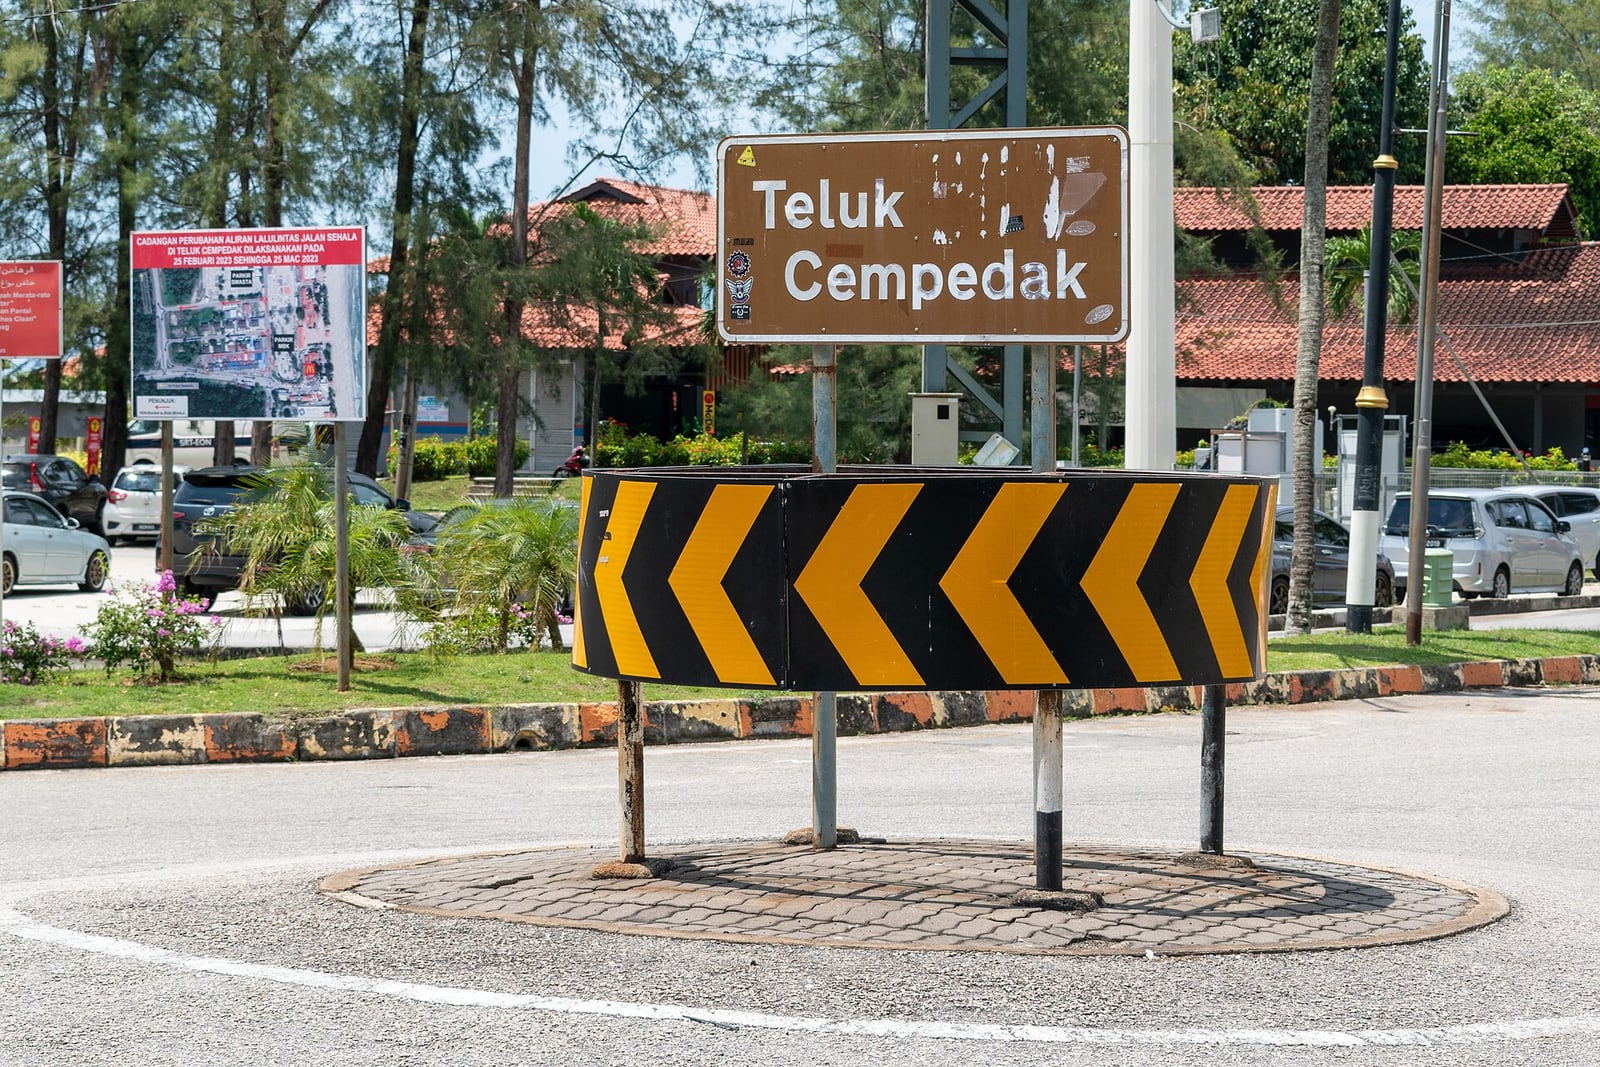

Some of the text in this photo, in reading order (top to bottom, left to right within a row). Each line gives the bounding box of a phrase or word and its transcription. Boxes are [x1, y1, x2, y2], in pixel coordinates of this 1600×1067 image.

[752, 177, 905, 230] Teluk
[136, 232, 358, 246] CADANGAN PERUBAHAN ALIRAN LALULINTAS JALAN SEHALA
[167, 243, 325, 256] DI TELUK CEMPEDAK DILAKSANAKAN PADA
[173, 254, 319, 266] 25 FEBUARI 2023 SEHINGGA 25 MAC 2023
[784, 248, 1088, 310] Cempedak
[179, 438, 212, 447] SRT-EON
